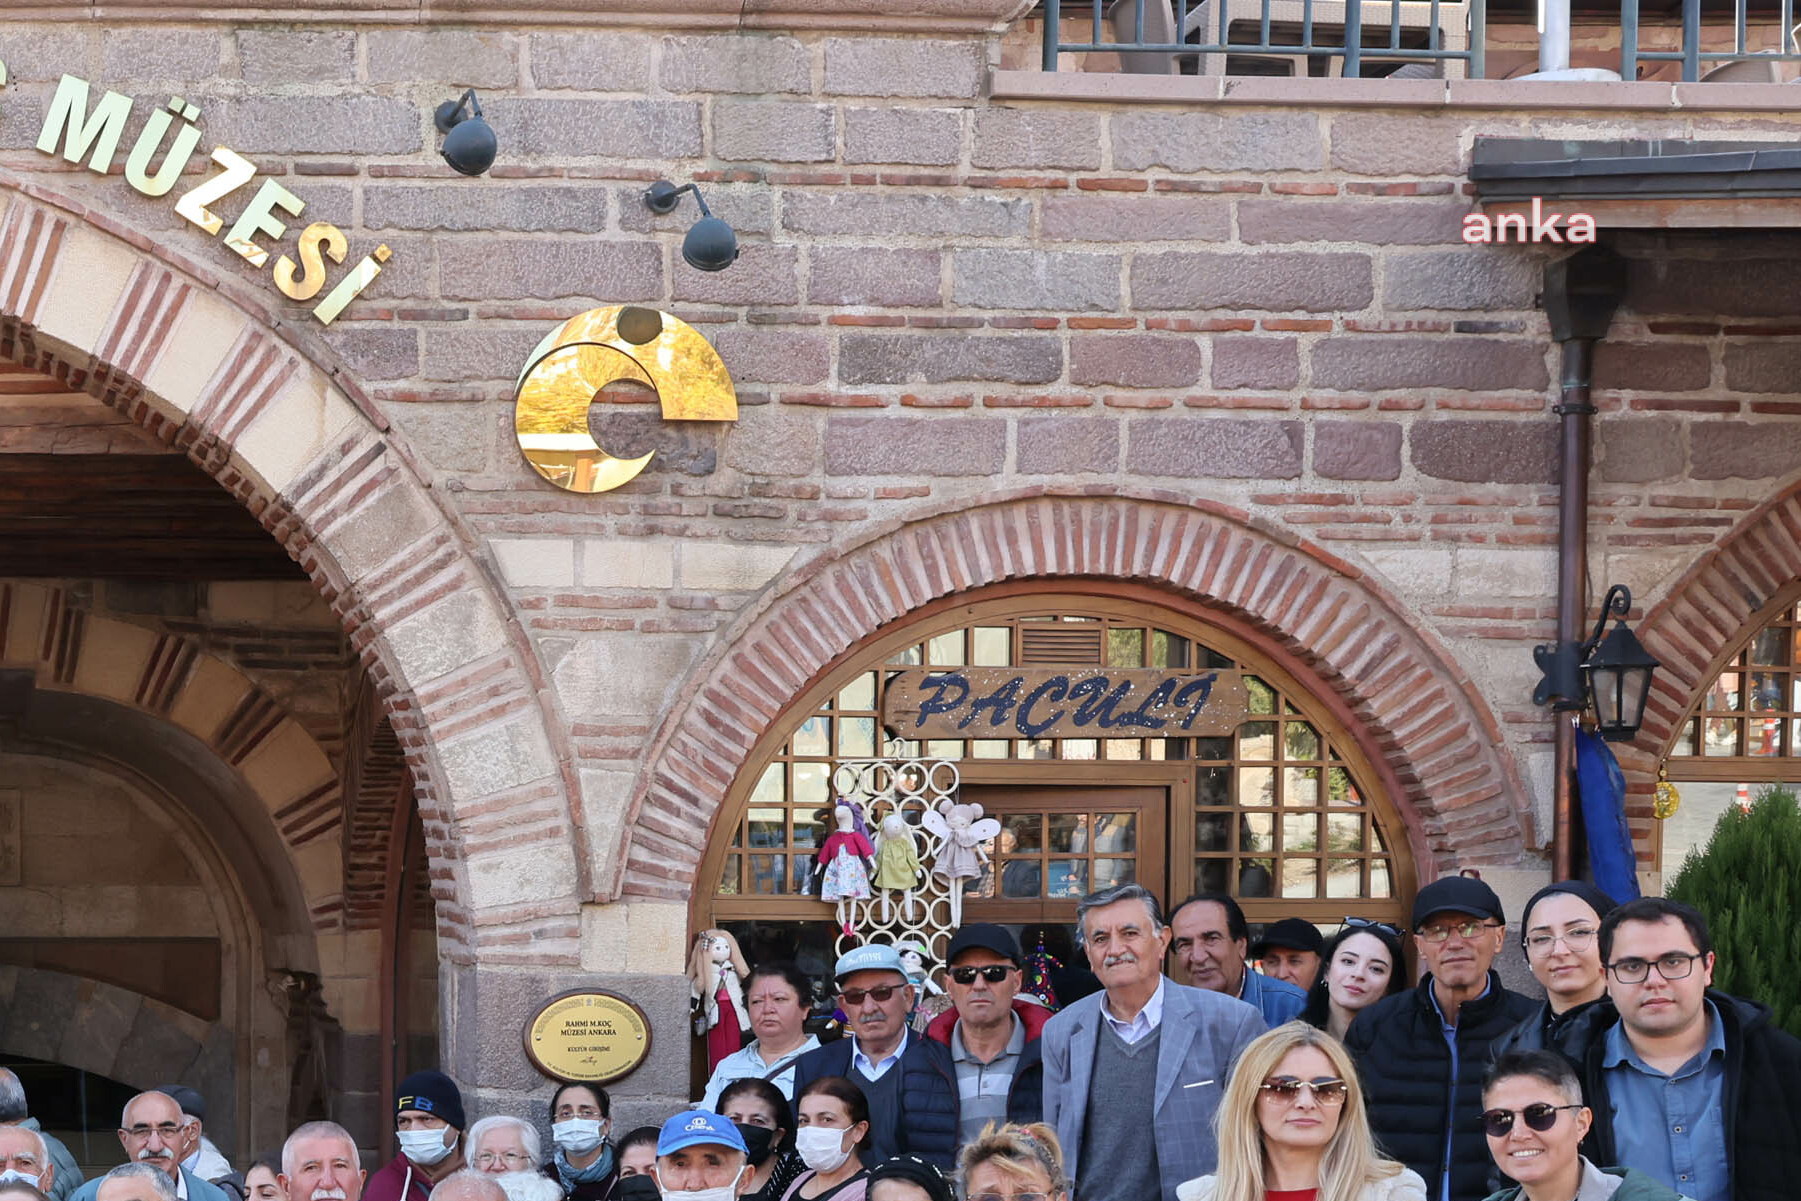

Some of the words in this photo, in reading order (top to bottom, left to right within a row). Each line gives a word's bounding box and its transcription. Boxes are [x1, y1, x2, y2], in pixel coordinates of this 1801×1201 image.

[35, 73, 393, 326] MÜZESİ
[560, 1028, 586, 1036] MÜZESİ
[588, 1028, 617, 1036] ANKARA
[398, 1095, 433, 1111] FB
